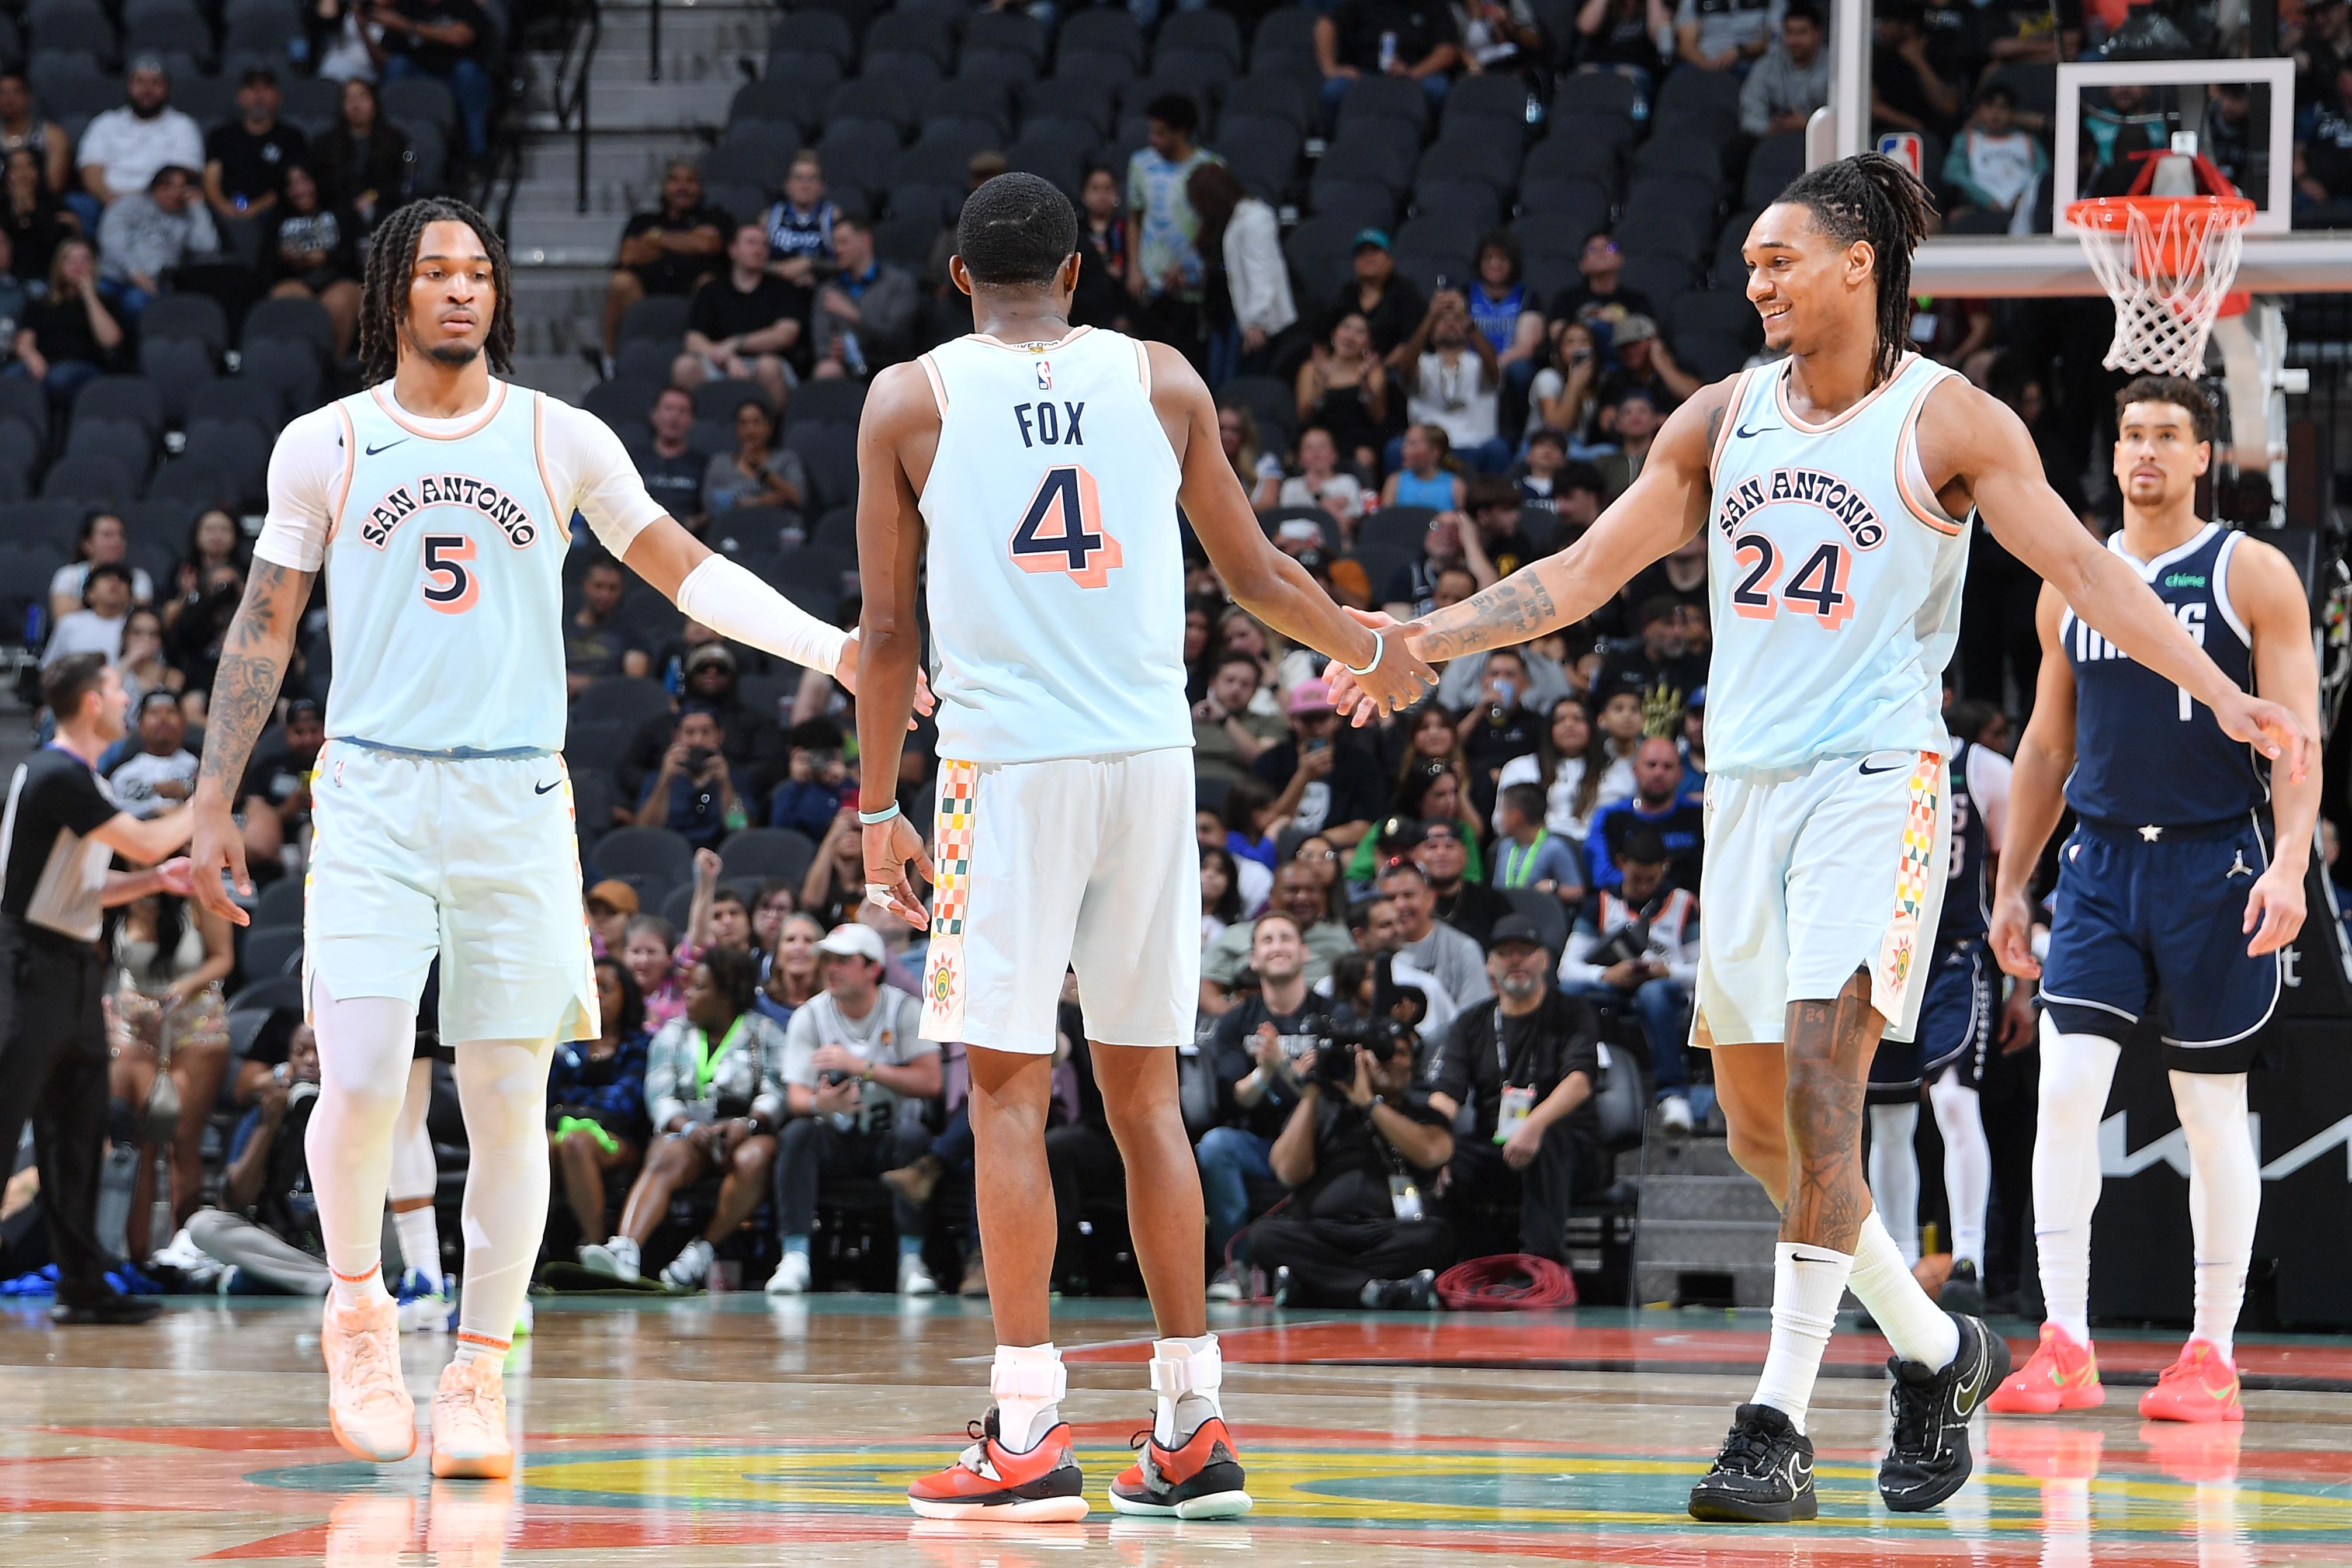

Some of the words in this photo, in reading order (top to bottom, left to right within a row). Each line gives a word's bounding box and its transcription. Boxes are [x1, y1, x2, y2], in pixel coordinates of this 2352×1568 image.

[1014, 401, 1085, 448] FOX
[363, 488, 417, 546] SAN
[422, 477, 535, 546] ANTONIO
[1012, 468, 1102, 569] 4
[1720, 479, 1764, 539] SAN
[1772, 471, 1882, 547] ANTONIO
[424, 536, 467, 602] 5
[1733, 534, 1844, 616] 24
[2164, 572, 2206, 588] chime
